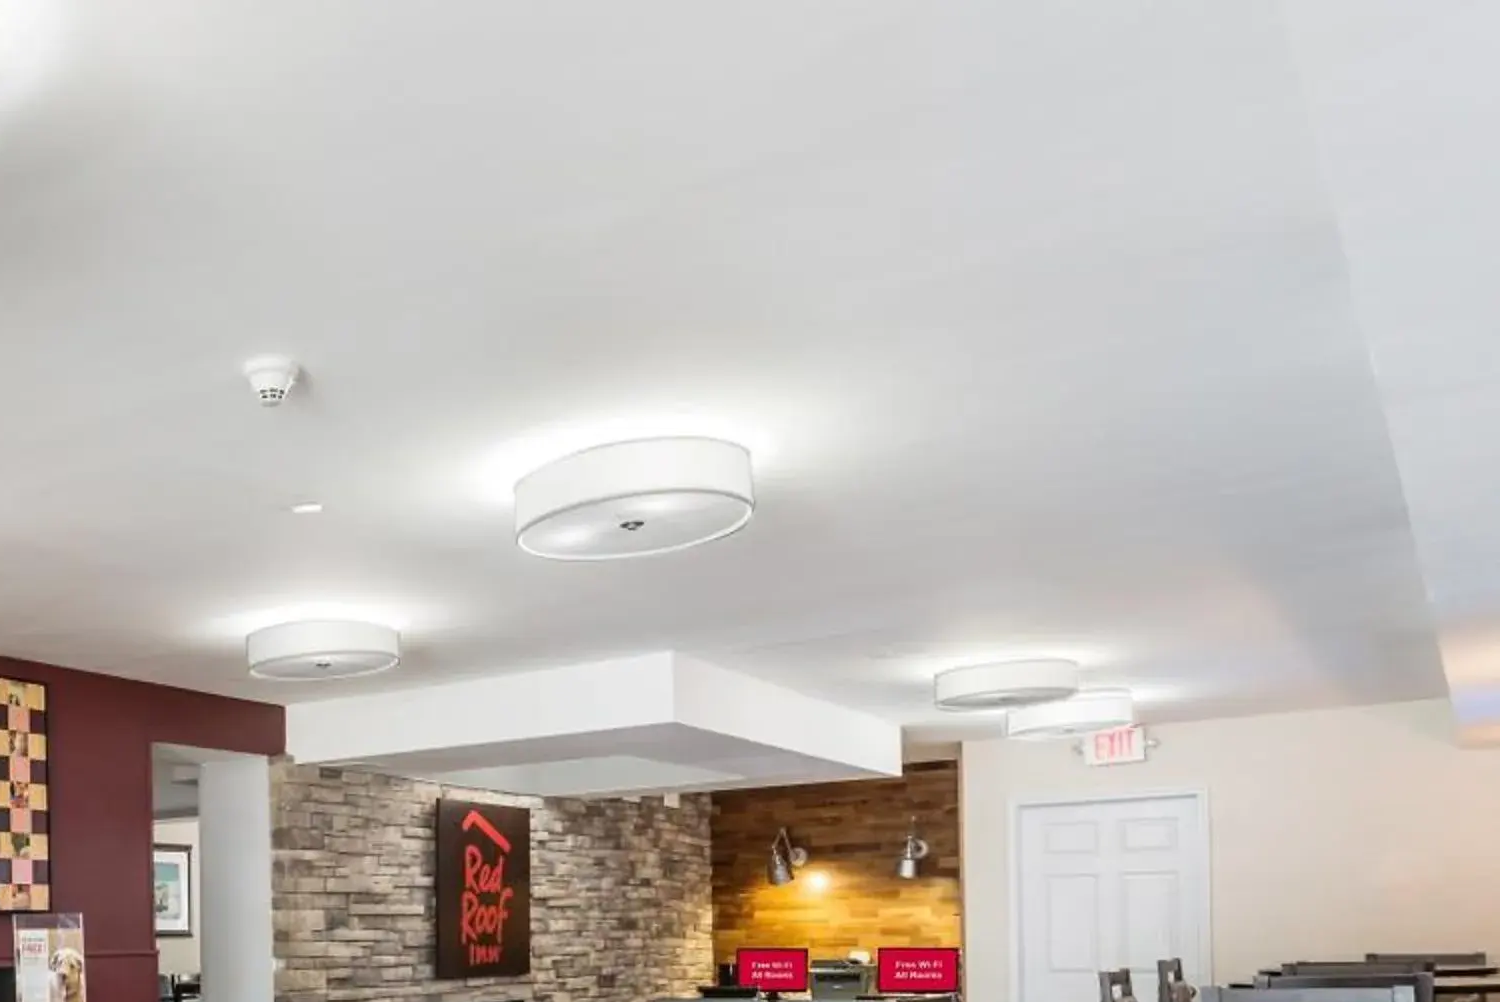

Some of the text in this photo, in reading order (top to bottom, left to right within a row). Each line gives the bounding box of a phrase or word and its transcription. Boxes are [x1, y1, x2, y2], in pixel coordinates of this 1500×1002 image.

[1095, 728, 1136, 761] EXIT
[465, 845, 505, 893] Red
[462, 888, 513, 944] Roof
